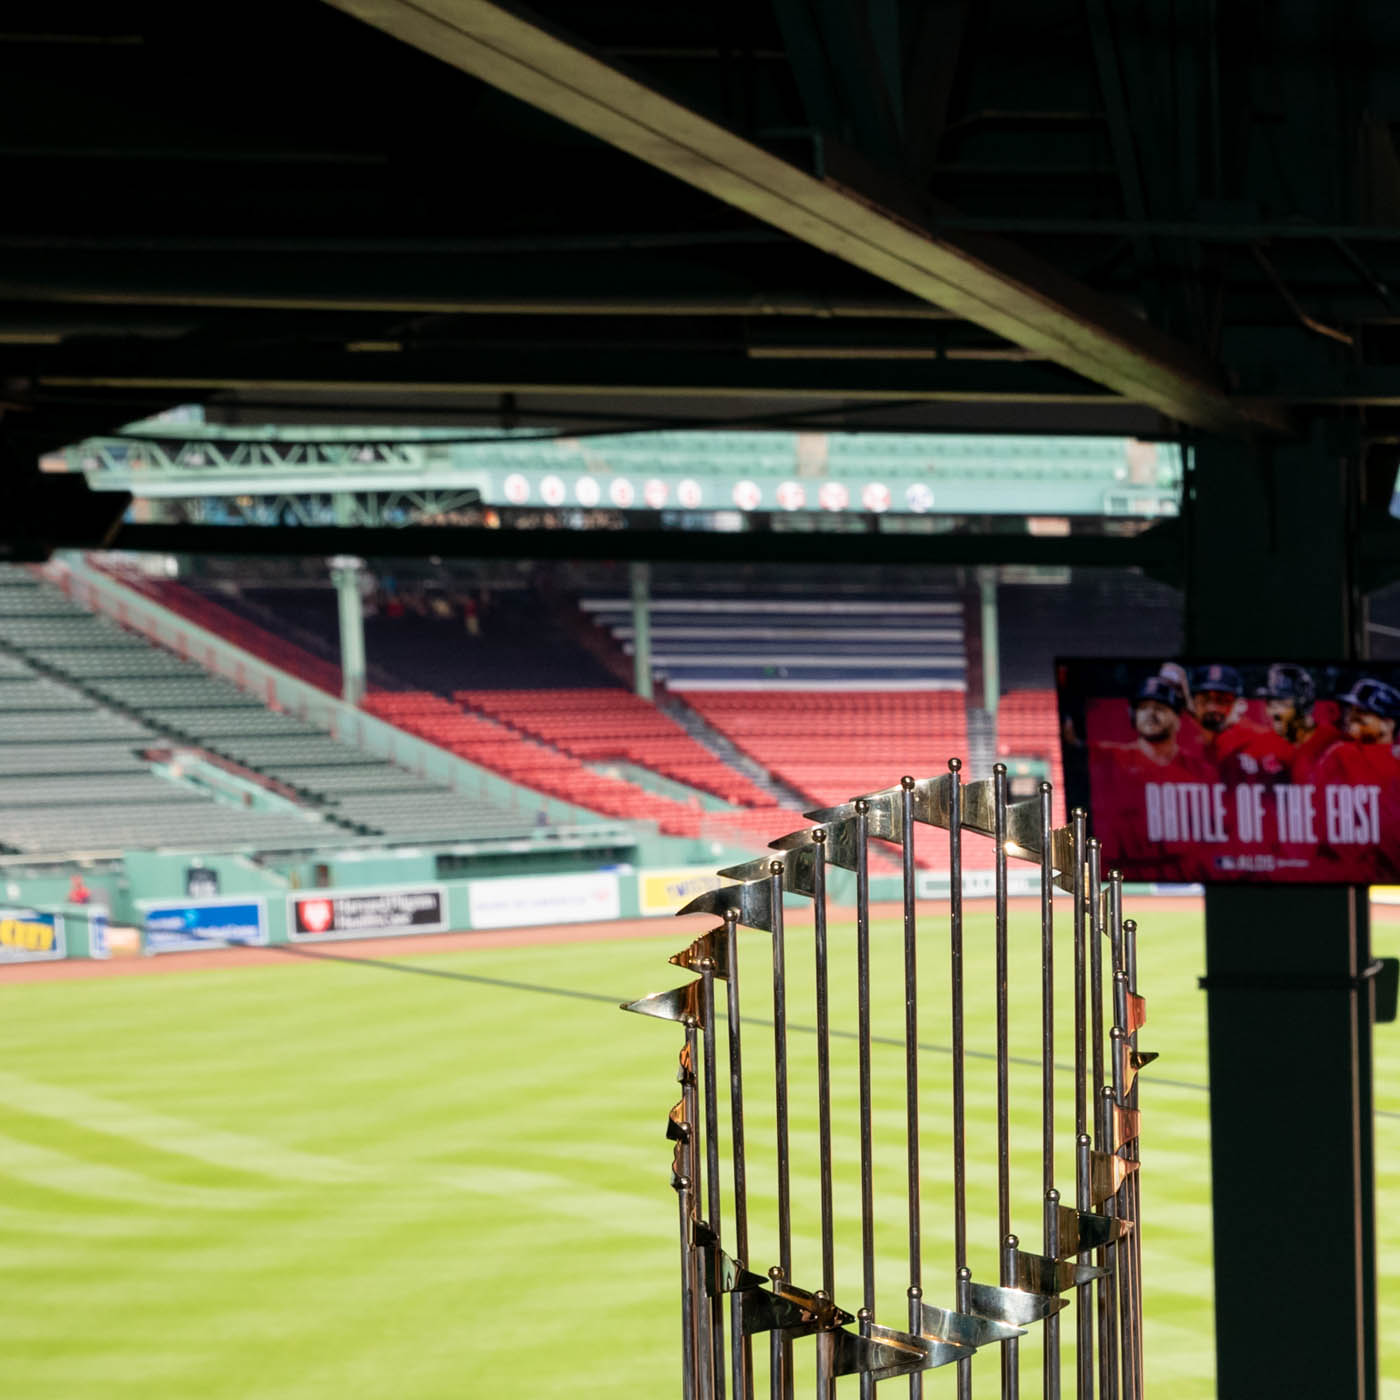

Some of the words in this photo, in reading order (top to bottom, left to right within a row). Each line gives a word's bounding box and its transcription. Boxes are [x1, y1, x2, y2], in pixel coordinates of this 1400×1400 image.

[1145, 782, 1229, 842] BATTLE
[1236, 782, 1266, 844] OF
[1273, 783, 1318, 844] THE
[1325, 784, 1381, 845] EAST
